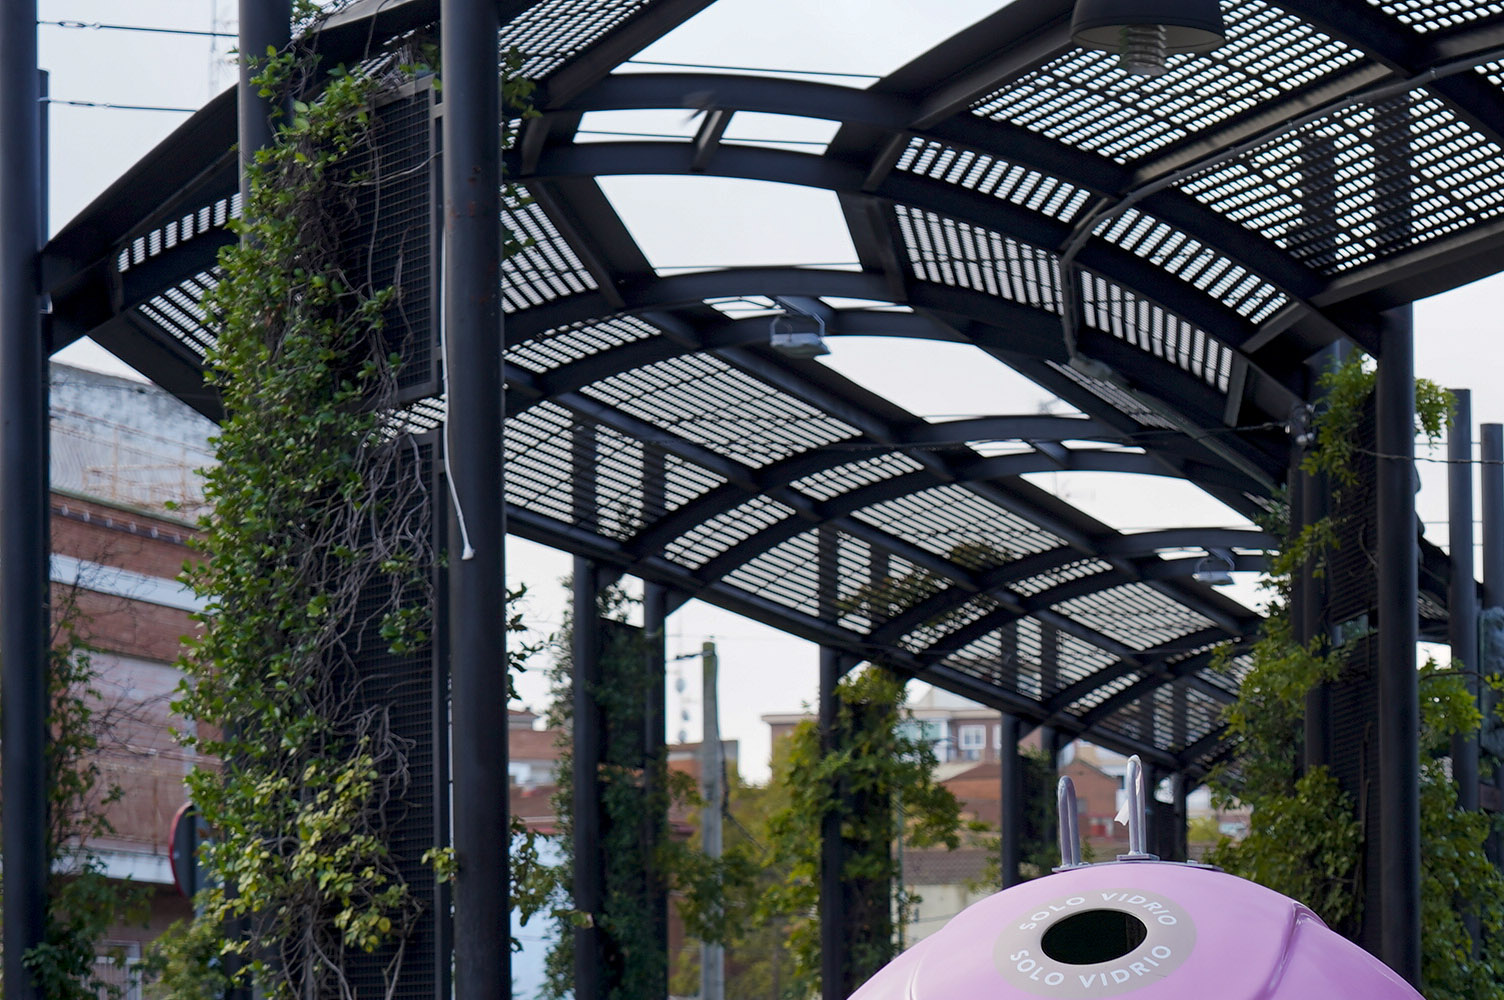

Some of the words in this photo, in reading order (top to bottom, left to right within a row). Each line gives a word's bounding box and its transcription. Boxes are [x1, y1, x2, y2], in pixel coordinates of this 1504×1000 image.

[1019, 896, 1086, 931] SOLO
[1101, 892, 1177, 926] VIDRIO
[1010, 949, 1065, 986] SOLO
[1078, 945, 1172, 989] VIDRIO
